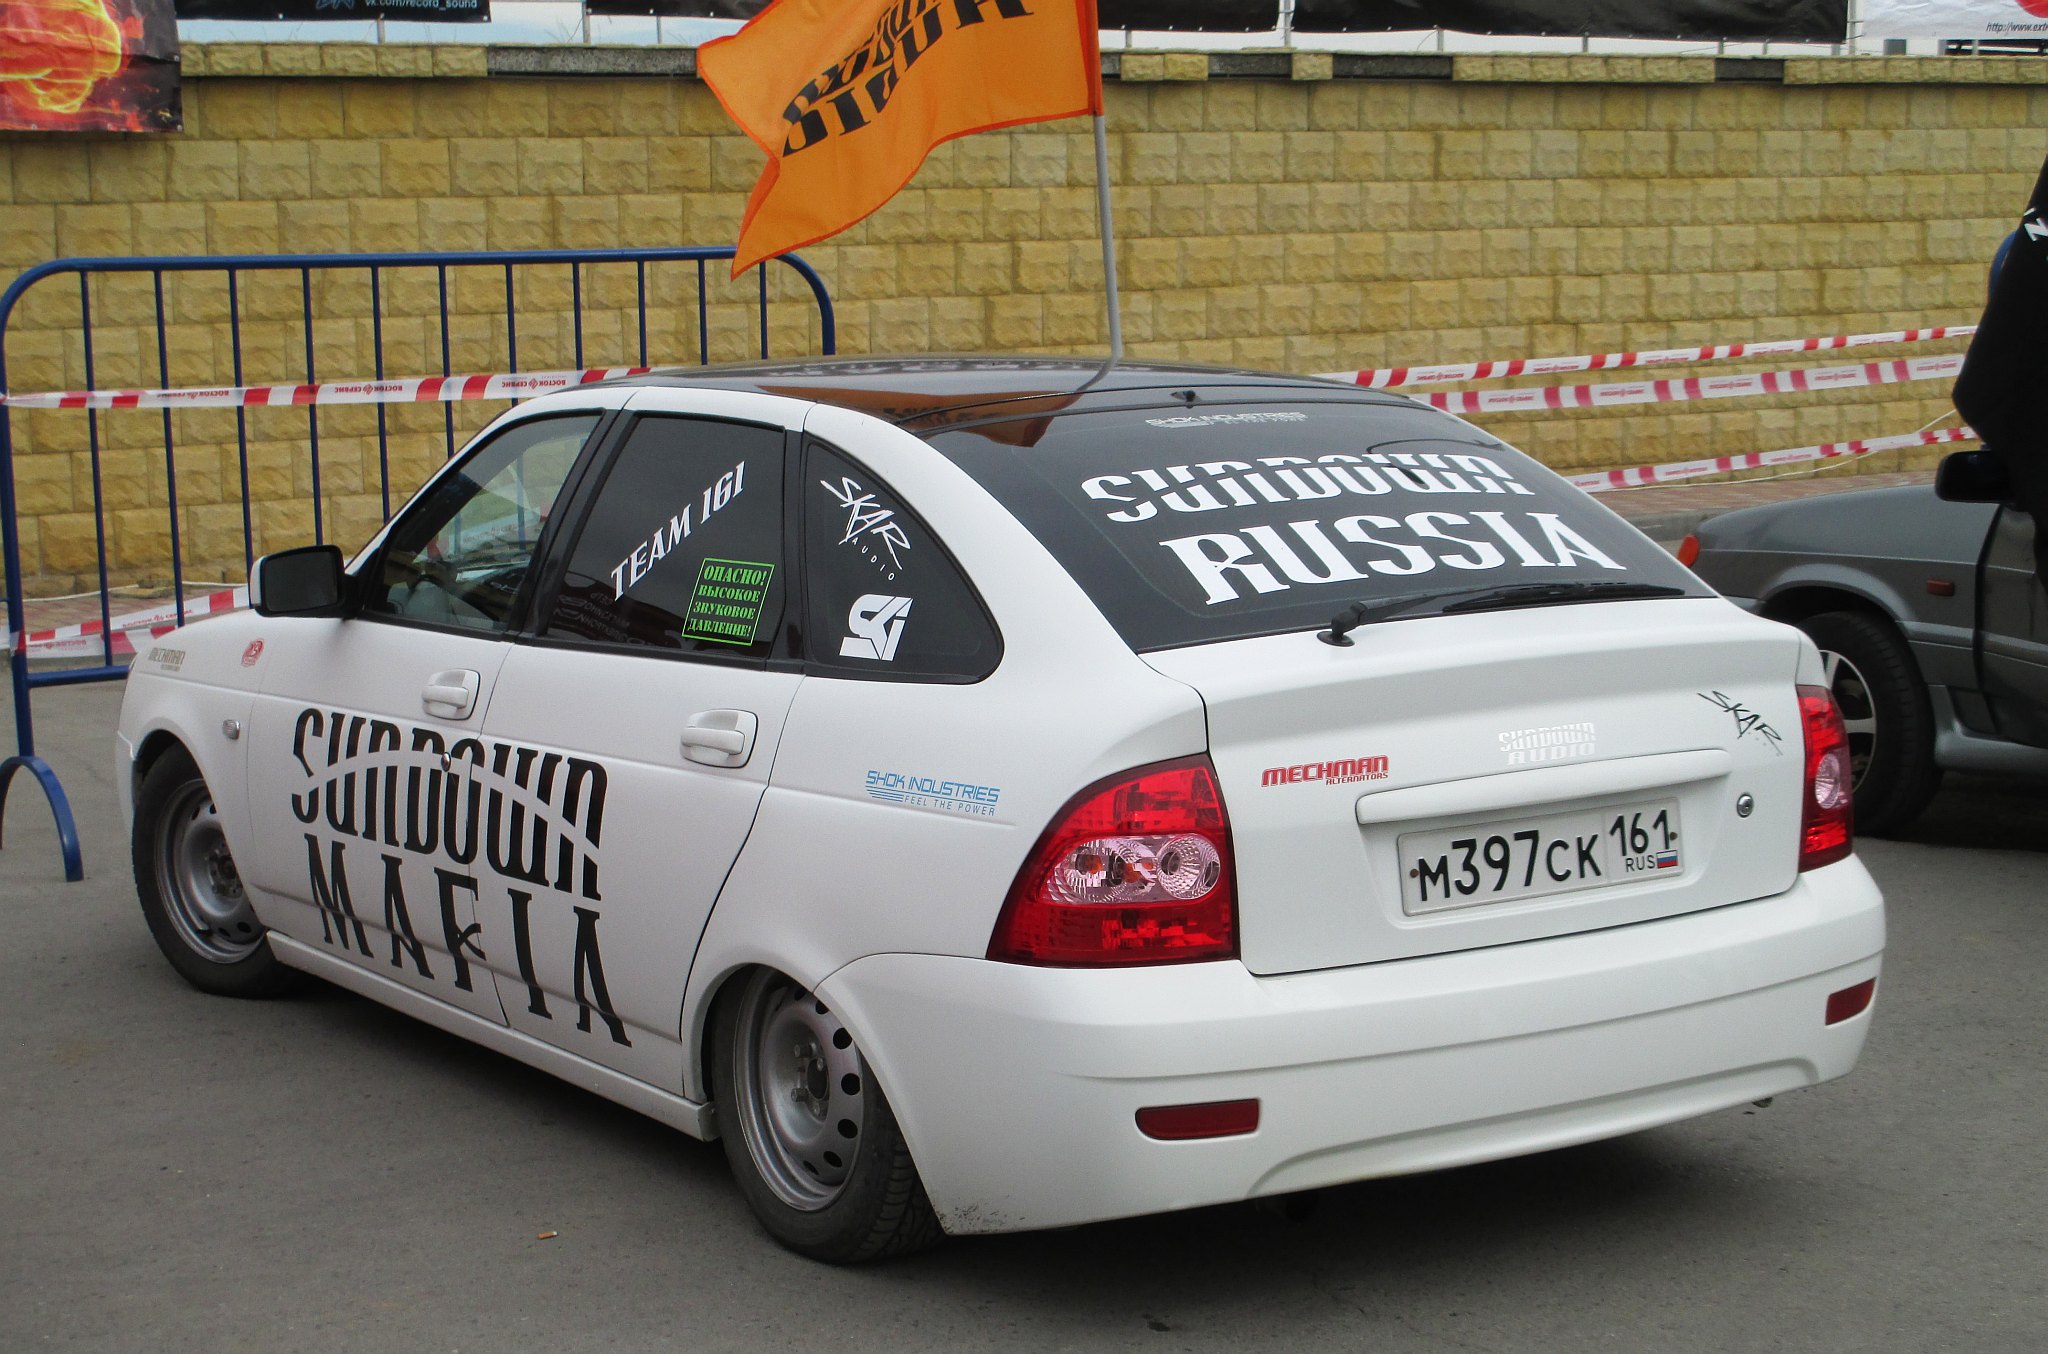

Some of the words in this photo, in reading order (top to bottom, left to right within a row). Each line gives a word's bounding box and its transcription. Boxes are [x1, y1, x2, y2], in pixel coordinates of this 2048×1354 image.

[1080, 453, 1536, 524] SUNDOWN
[820, 476, 912, 571] SKAR
[610, 503, 692, 602] TEAM
[851, 536, 896, 581] AUDIO
[1158, 511, 1628, 606] RUSSIA
[703, 564, 768, 587] ОПАСНО!
[697, 584, 761, 603] ВЫСОКОЕ
[693, 601, 756, 620] ЗВУКОВОЕ
[687, 618, 752, 638] ДАВЛЕНИЕ!
[1498, 722, 1597, 752] SUNDOWN
[1508, 742, 1596, 766] AUDIO
[865, 770, 906, 790] SHOK
[908, 776, 1001, 803] INDUSTRIES
[1260, 754, 1389, 788] MECHMAN
[1325, 772, 1389, 786] ALTERNATORS
[291, 707, 609, 902] SUNDOWN
[904, 795, 928, 807] FEEL
[934, 799, 953, 810] THE
[958, 802, 996, 817] POWER
[1608, 809, 1671, 857] 161
[1625, 855, 1656, 873] RUS
[304, 832, 633, 1049] MAFIA
